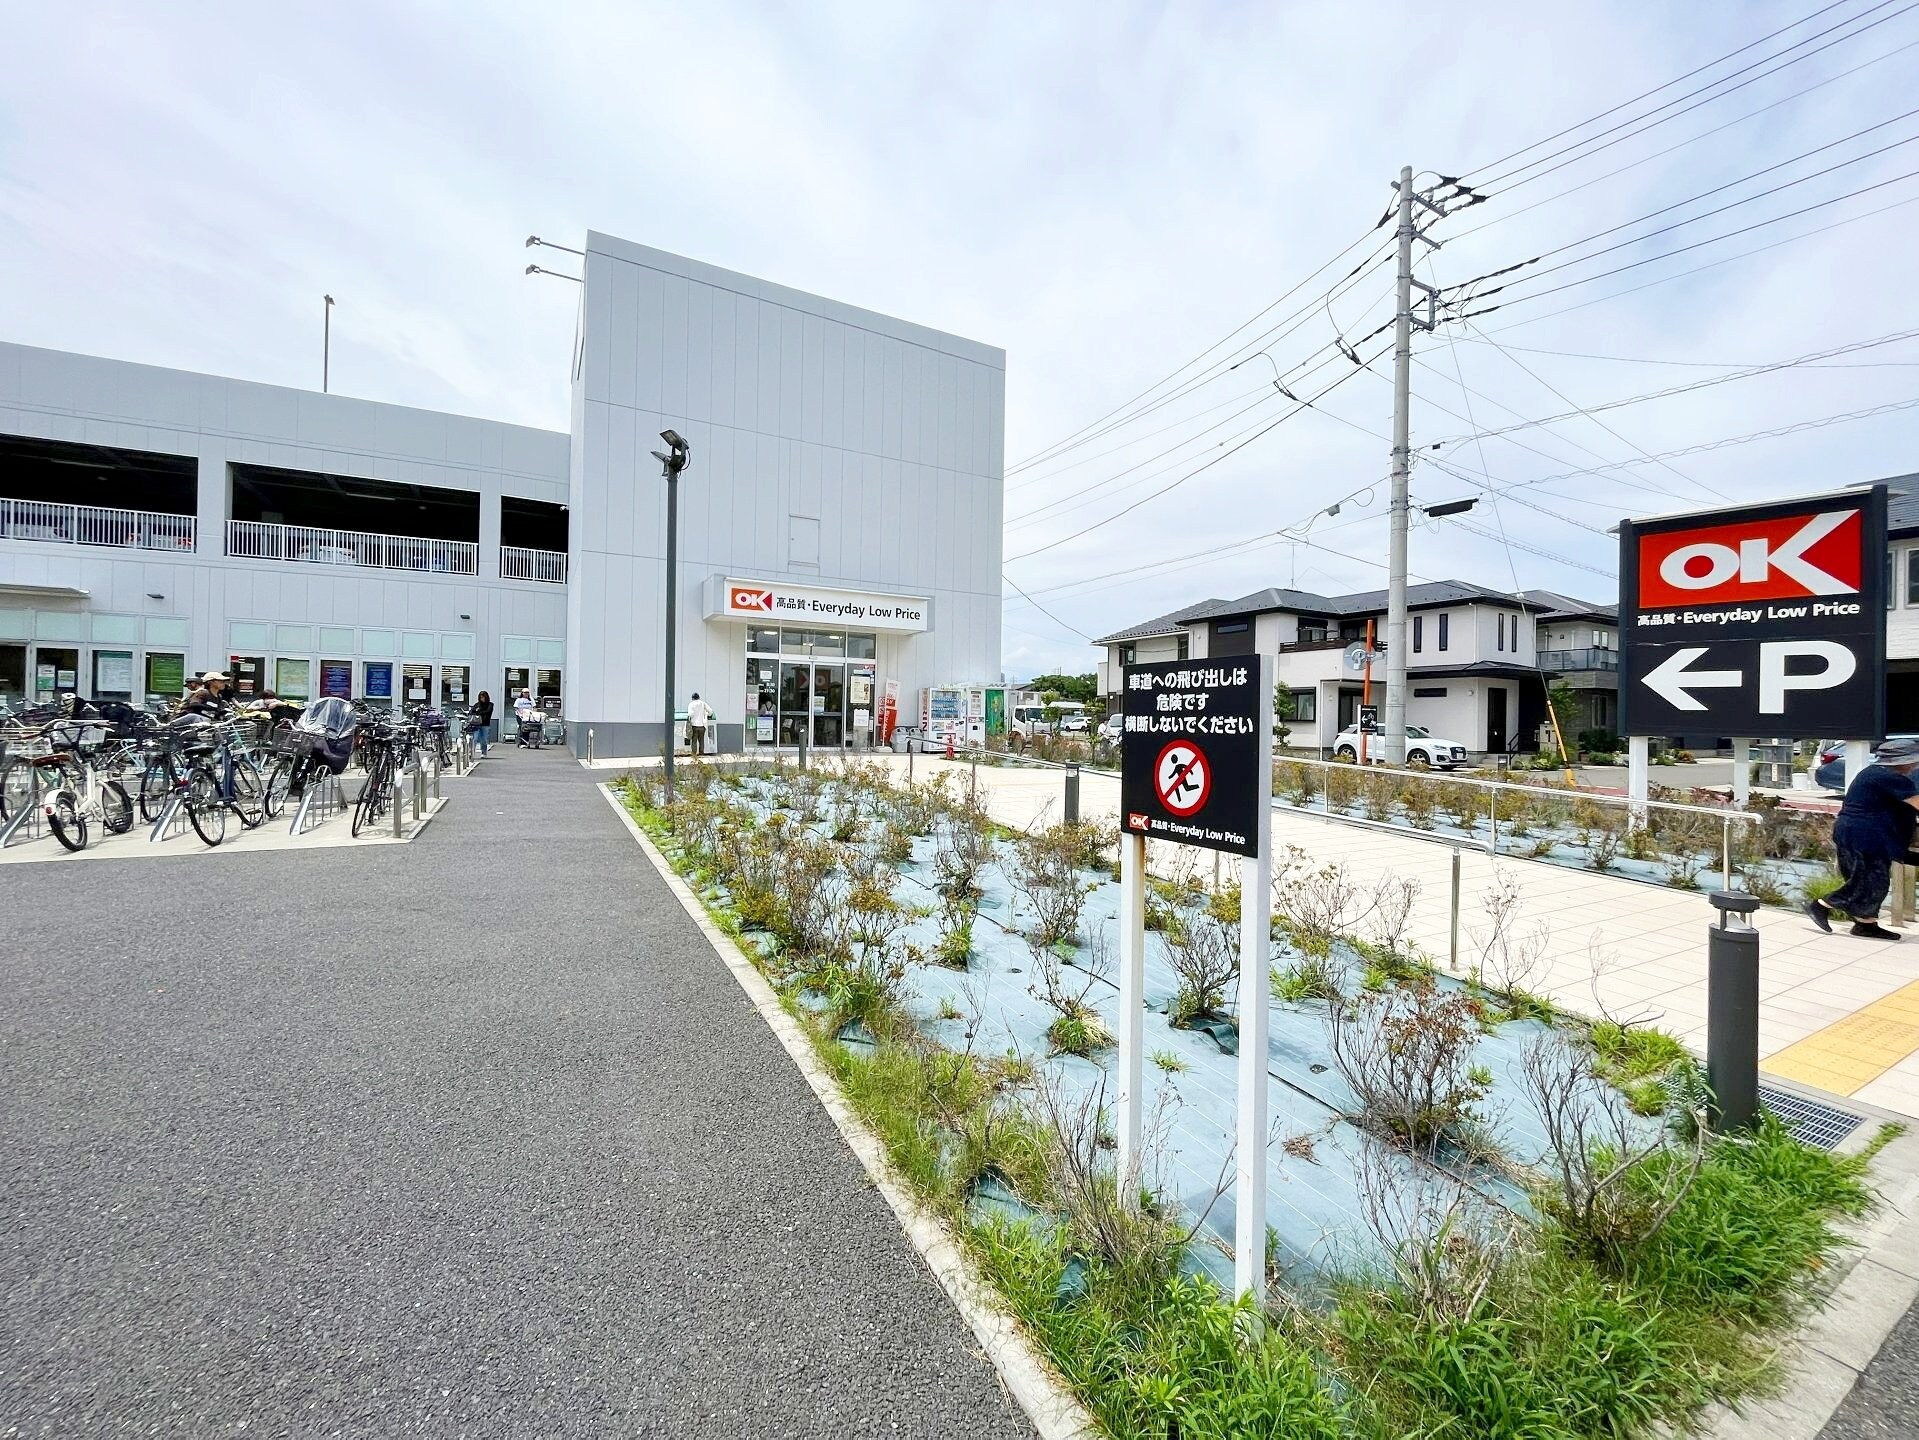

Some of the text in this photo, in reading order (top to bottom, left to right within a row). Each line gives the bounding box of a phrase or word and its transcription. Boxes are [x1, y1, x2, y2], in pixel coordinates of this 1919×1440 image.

[1659, 508, 1860, 596] OK
[735, 591, 772, 612] OK
[1767, 605, 1807, 619] Low
[1812, 601, 1861, 617] Price
[869, 605, 892, 618] Low
[895, 607, 921, 620] Price
[1128, 667, 1248, 691] 車道への飛び出しは
[1759, 640, 1857, 714] P
[1156, 692, 1209, 711] 危険です
[1124, 715, 1254, 734] 横断しないでください
[1131, 815, 1149, 831] OK
[1205, 828, 1224, 841] Low
[1224, 831, 1246, 845] Price
